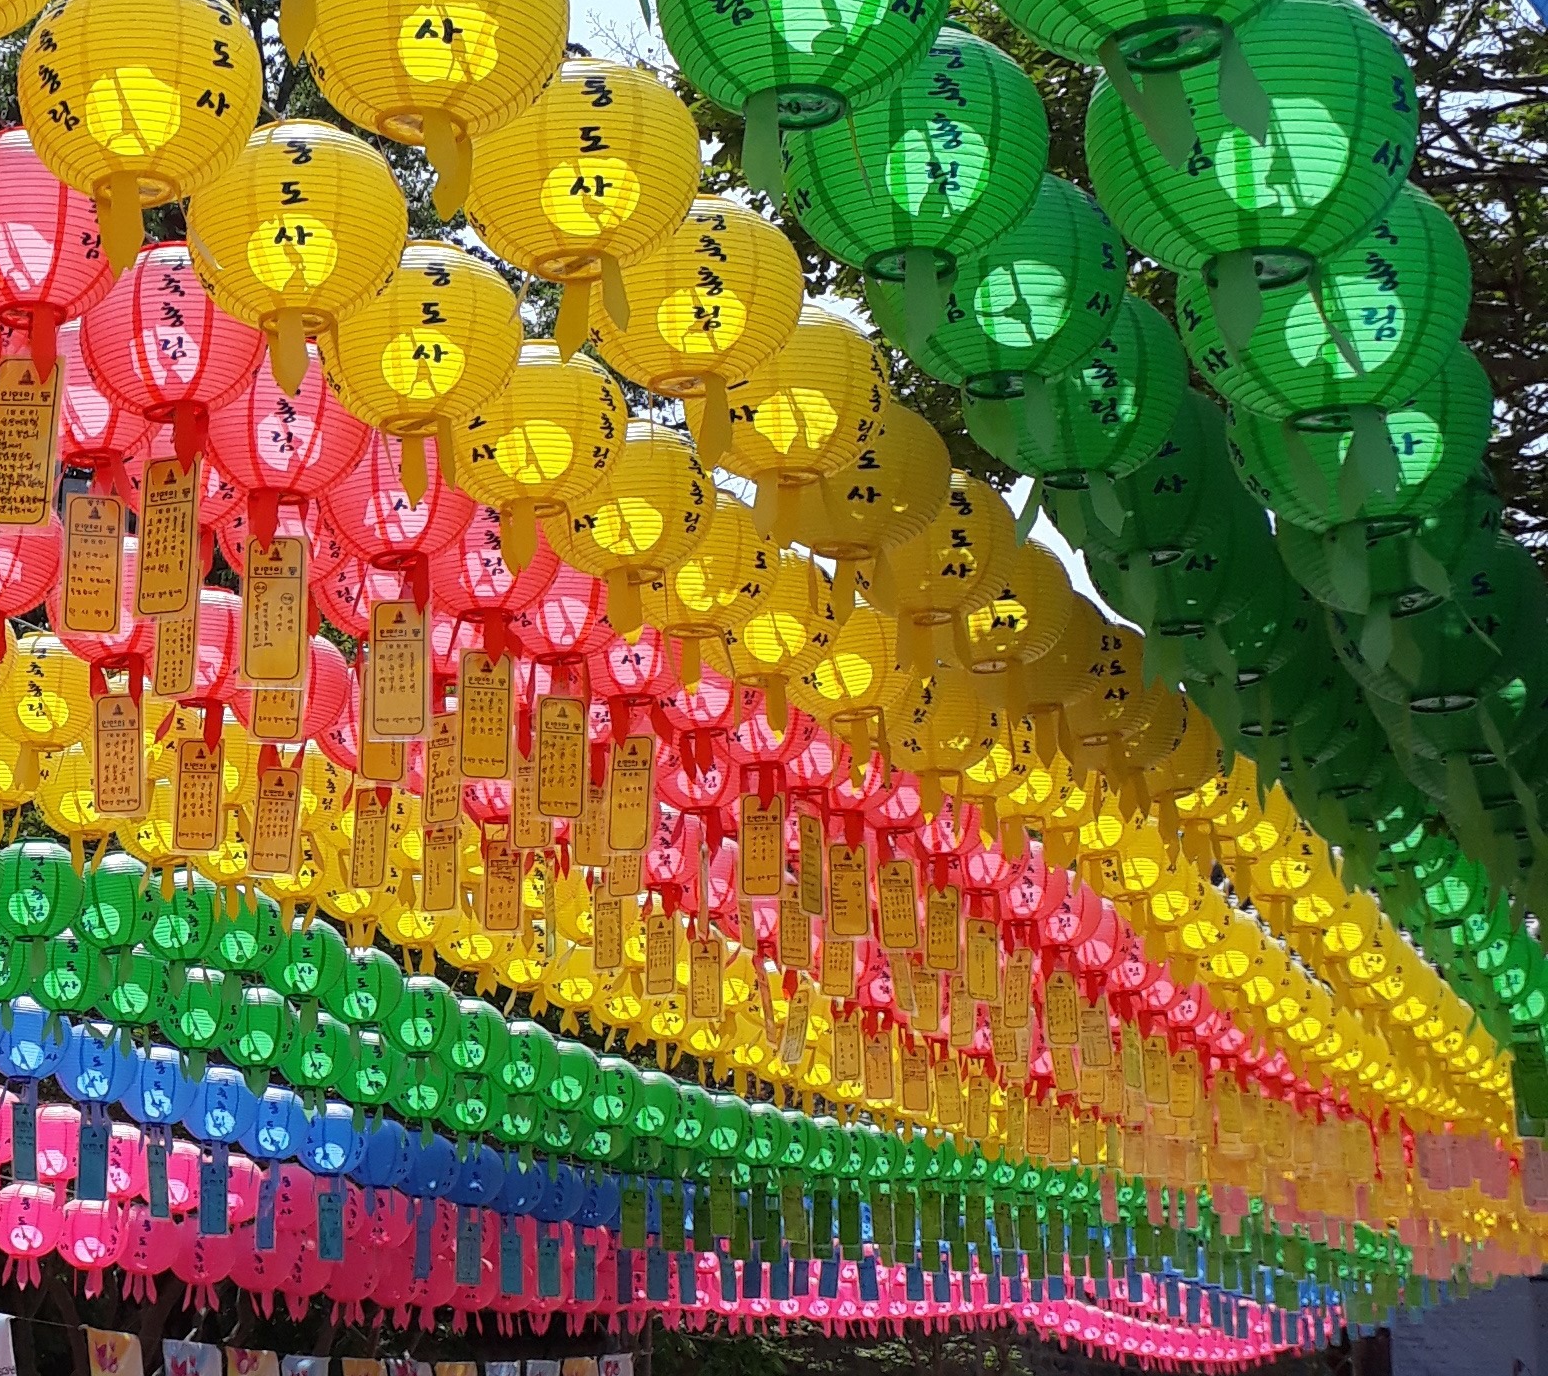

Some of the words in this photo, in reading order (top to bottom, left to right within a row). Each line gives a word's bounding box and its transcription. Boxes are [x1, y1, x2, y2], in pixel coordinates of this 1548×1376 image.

[569, 78, 614, 199] 통도사
[1, 391, 33, 401] 인연의
[40, 391, 50, 402] 등
